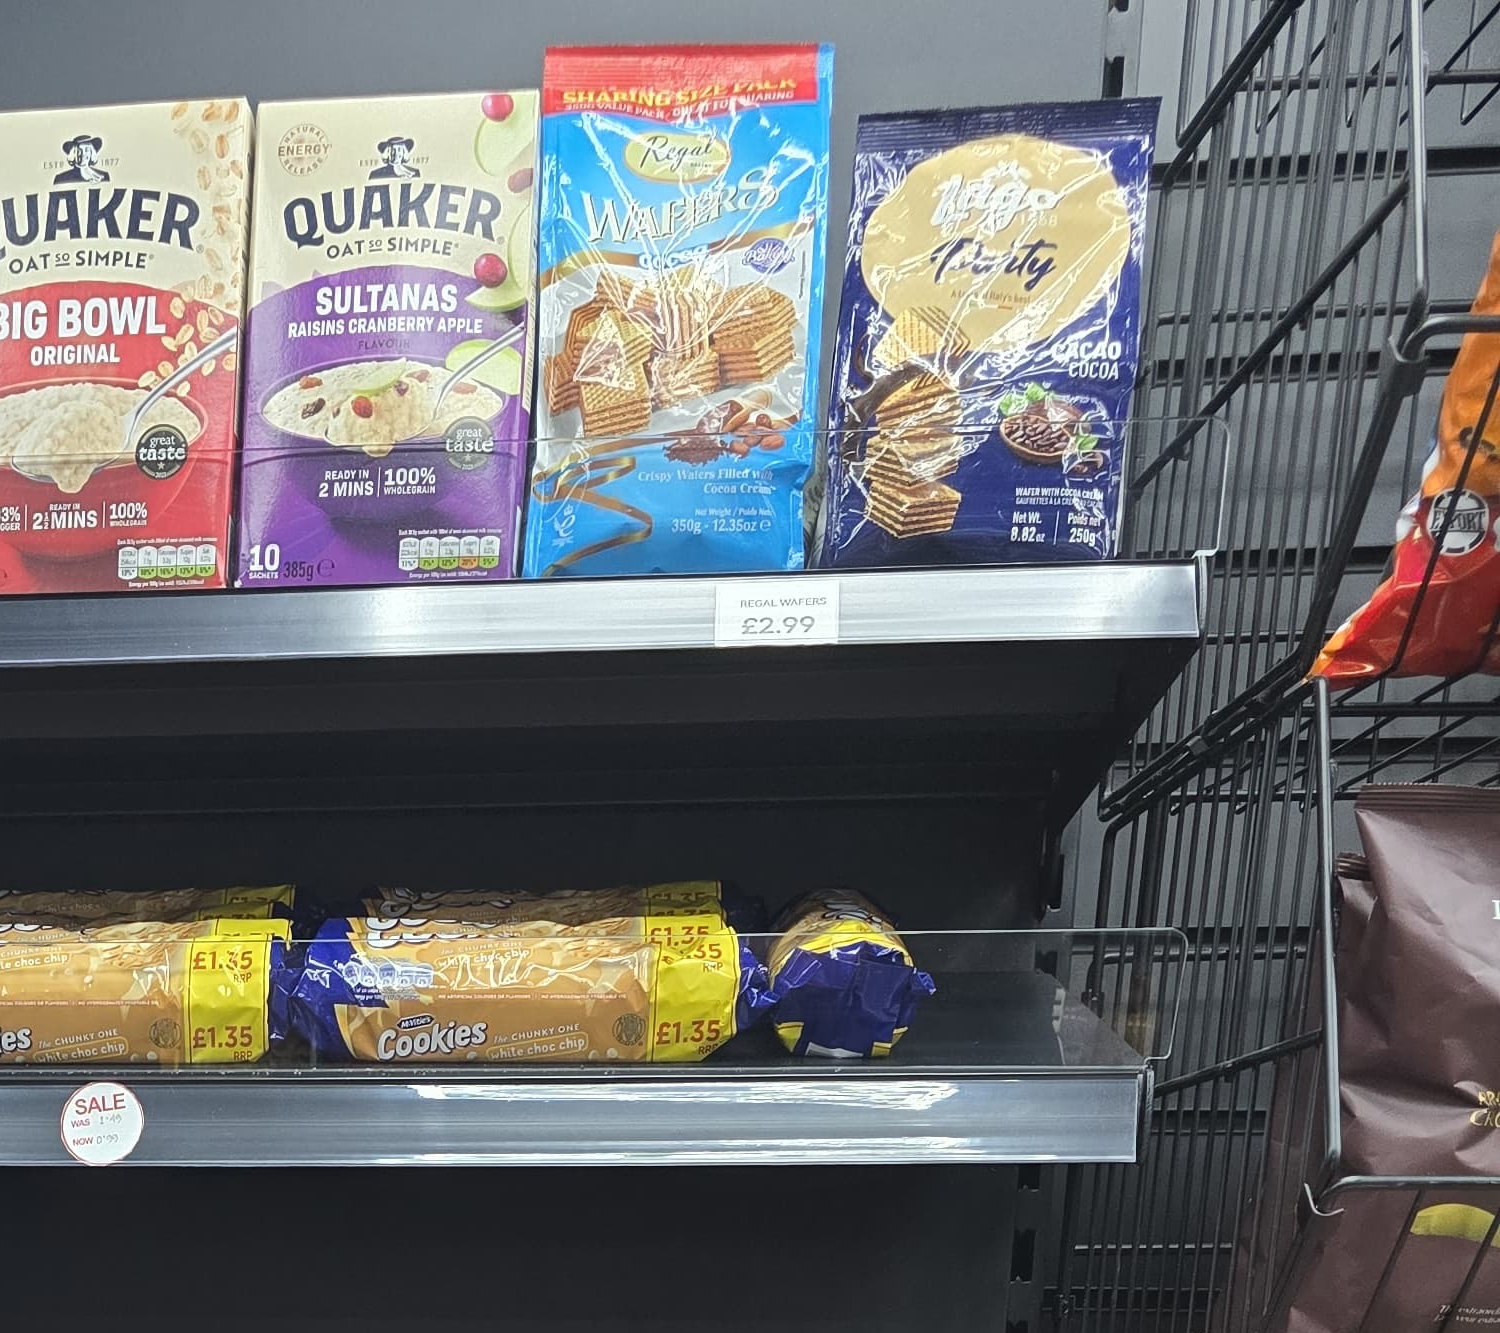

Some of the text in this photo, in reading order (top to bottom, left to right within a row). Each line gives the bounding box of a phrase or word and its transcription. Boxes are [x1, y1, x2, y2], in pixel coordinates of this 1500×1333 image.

[640, 134, 718, 172] Regal
[284, 182, 501, 249] QUAKER
[315, 282, 458, 317] SULTANAS
[58, 296, 167, 338] BOWL
[288, 315, 483, 337] RAISINS CRANBERRY APPLE
[30, 342, 121, 367] ORIGINAL
[1069, 361, 1119, 379] COCOA
[384, 467, 436, 485] 100%
[671, 518, 701, 534] 350g
[740, 596, 827, 608] REGAL WAFERS
[742, 615, 815, 635] £2.99
[191, 1025, 253, 1049] £1.35
[377, 1020, 487, 1060] Cookies
[655, 1020, 721, 1045] £1.35
[75, 1093, 126, 1115] SALE
